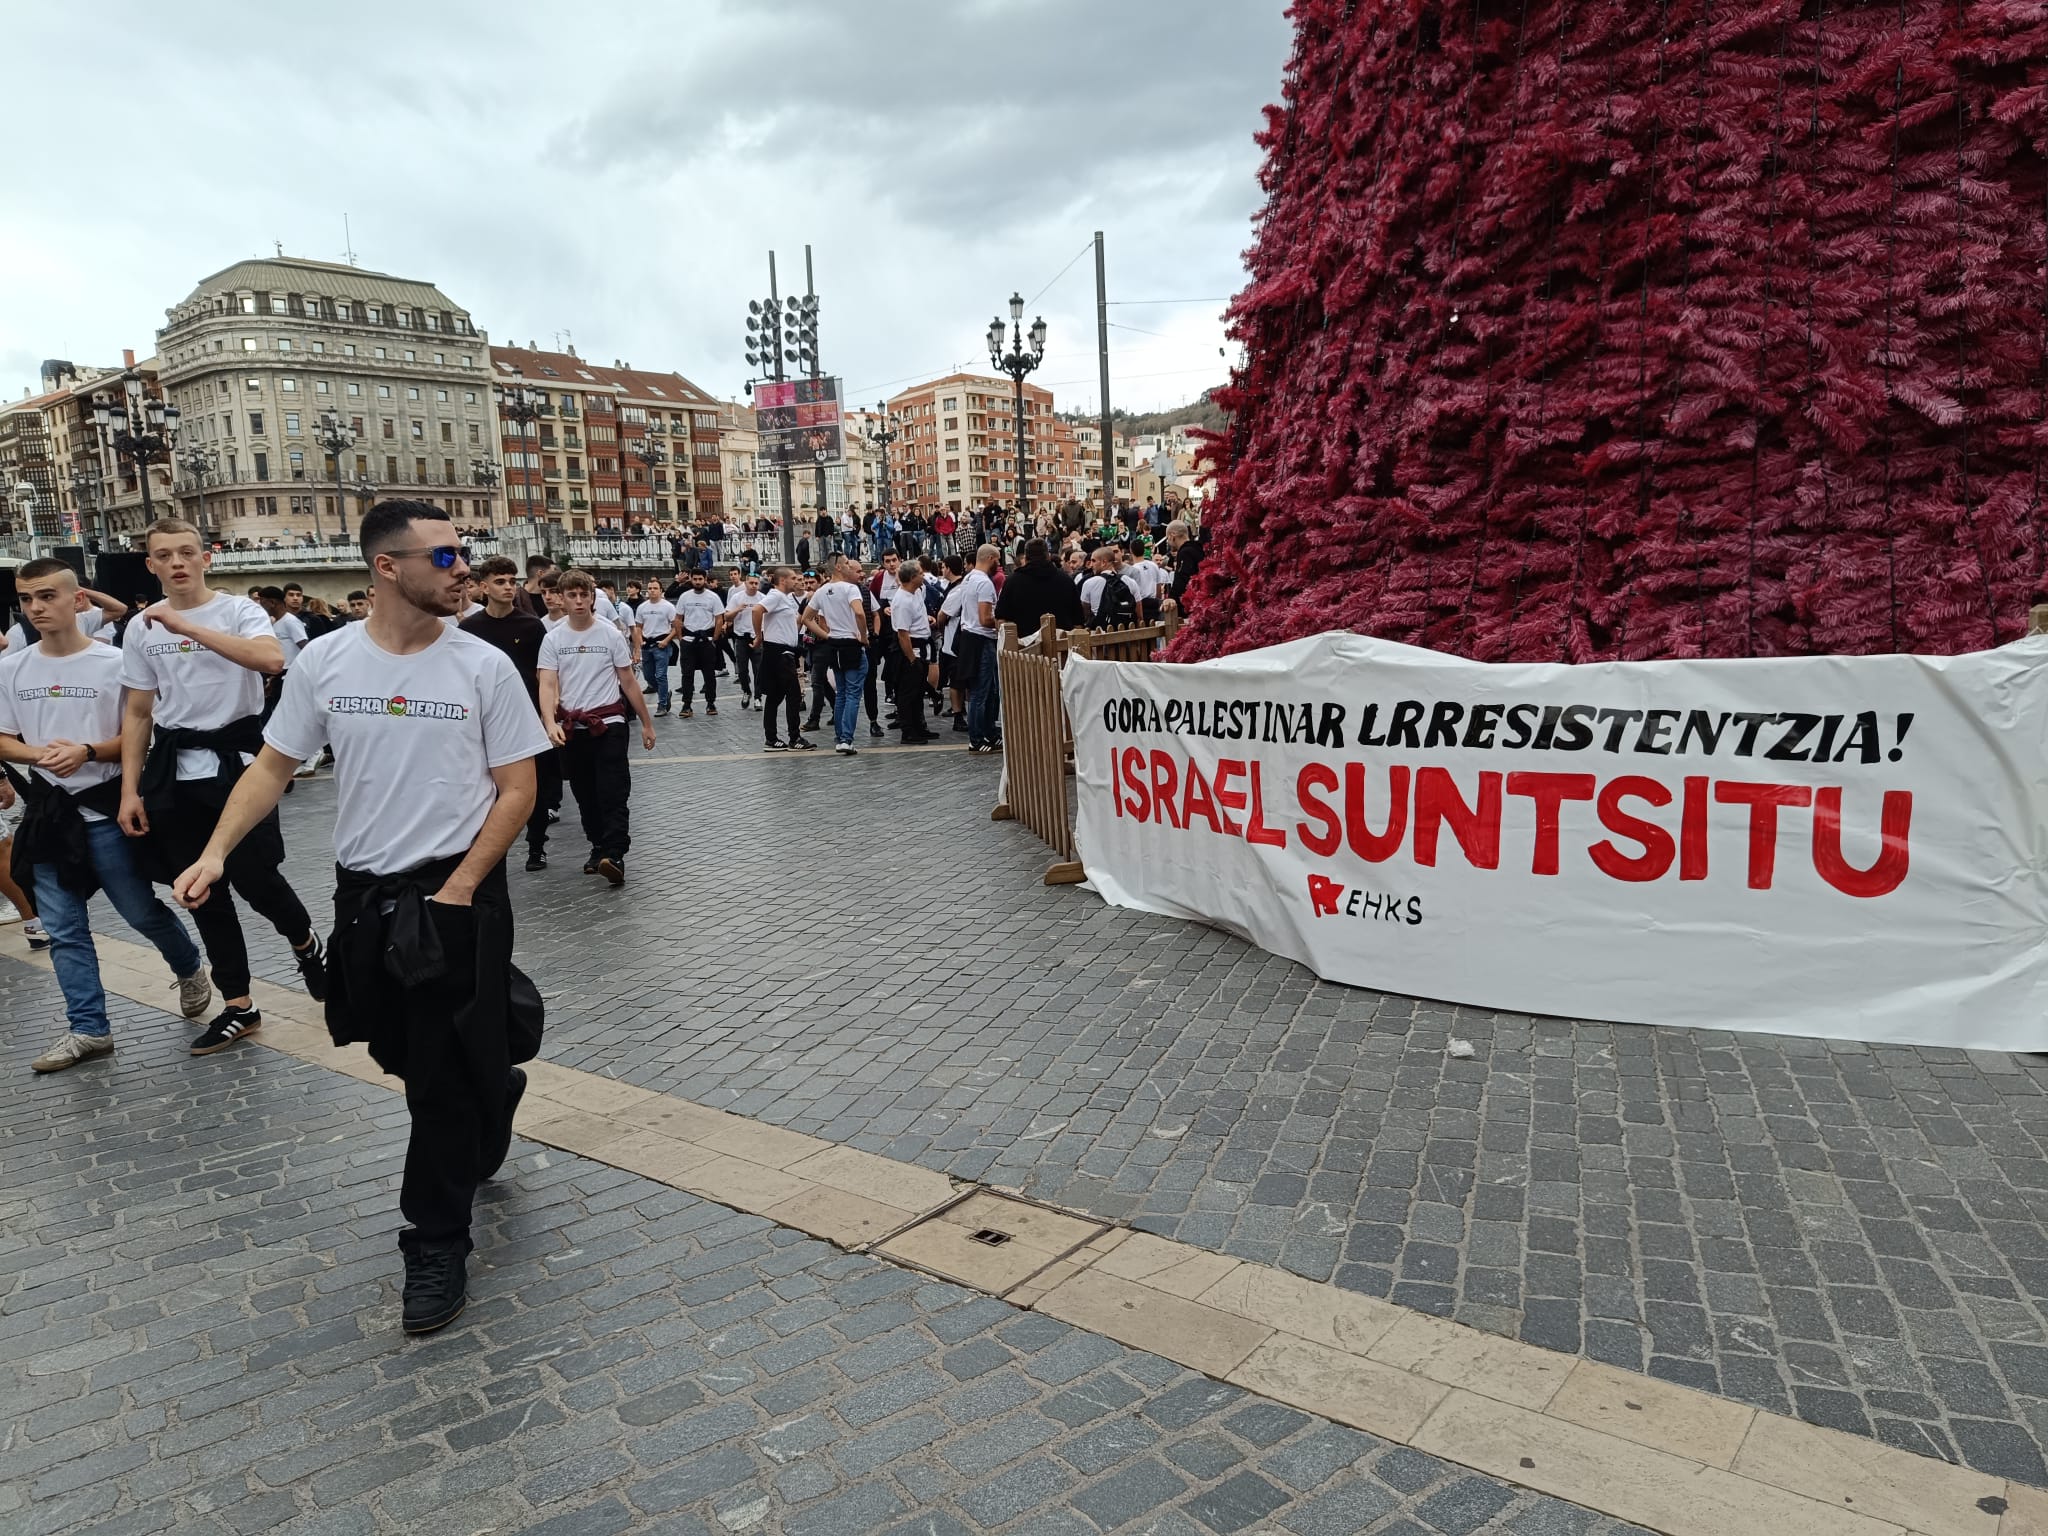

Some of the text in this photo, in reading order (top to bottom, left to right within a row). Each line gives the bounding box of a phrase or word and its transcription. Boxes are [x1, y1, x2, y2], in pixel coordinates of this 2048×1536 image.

[331, 696, 464, 720] EUSKAL HERRIA
[1103, 697, 1163, 734] GORA
[1164, 698, 1347, 748] PALESTINAR
[1111, 746, 1913, 898] ISRAEL SUNTSITU
[1345, 889, 1423, 925] EHKS
